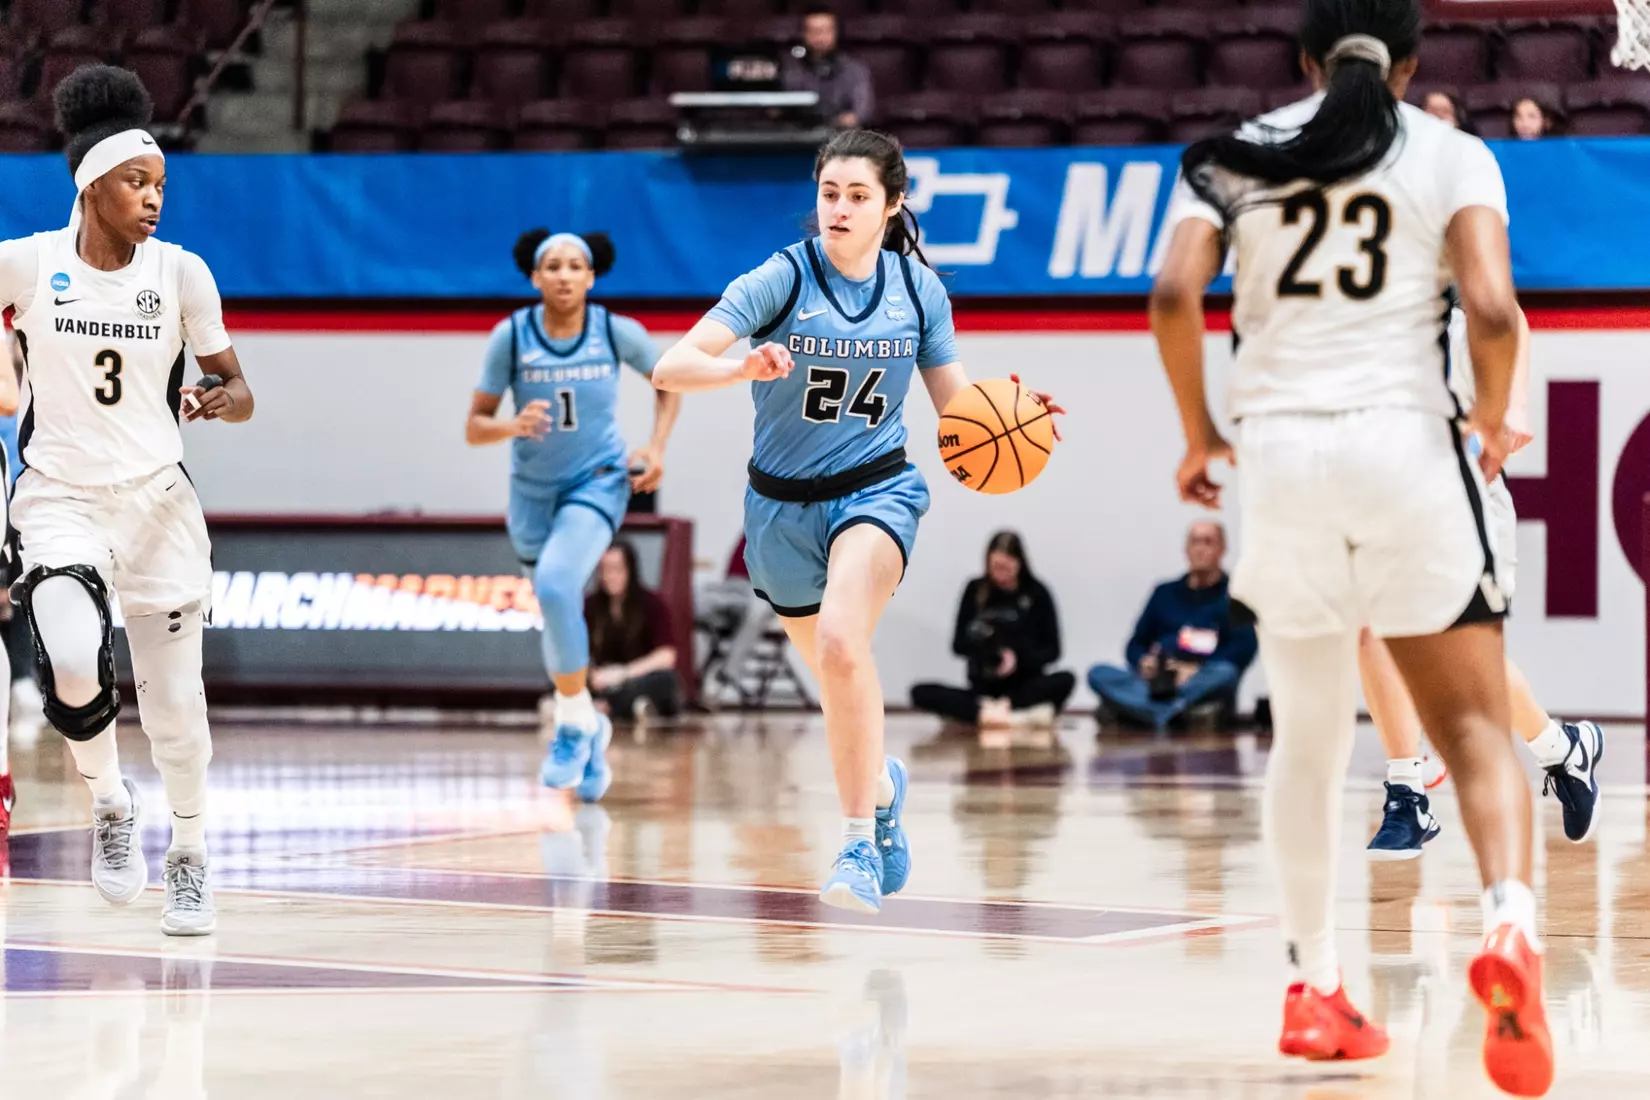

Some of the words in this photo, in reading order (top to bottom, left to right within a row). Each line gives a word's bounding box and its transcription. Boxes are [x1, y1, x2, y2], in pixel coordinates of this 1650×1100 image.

[1048, 161, 1182, 279] M
[1276, 188, 1394, 301] 23
[137, 290, 160, 313] SEC
[54, 317, 161, 340] VANDERBILT
[788, 334, 914, 359] COLUMBIA
[94, 348, 123, 406] 3
[801, 365, 888, 429] 24
[554, 386, 578, 432] 1
